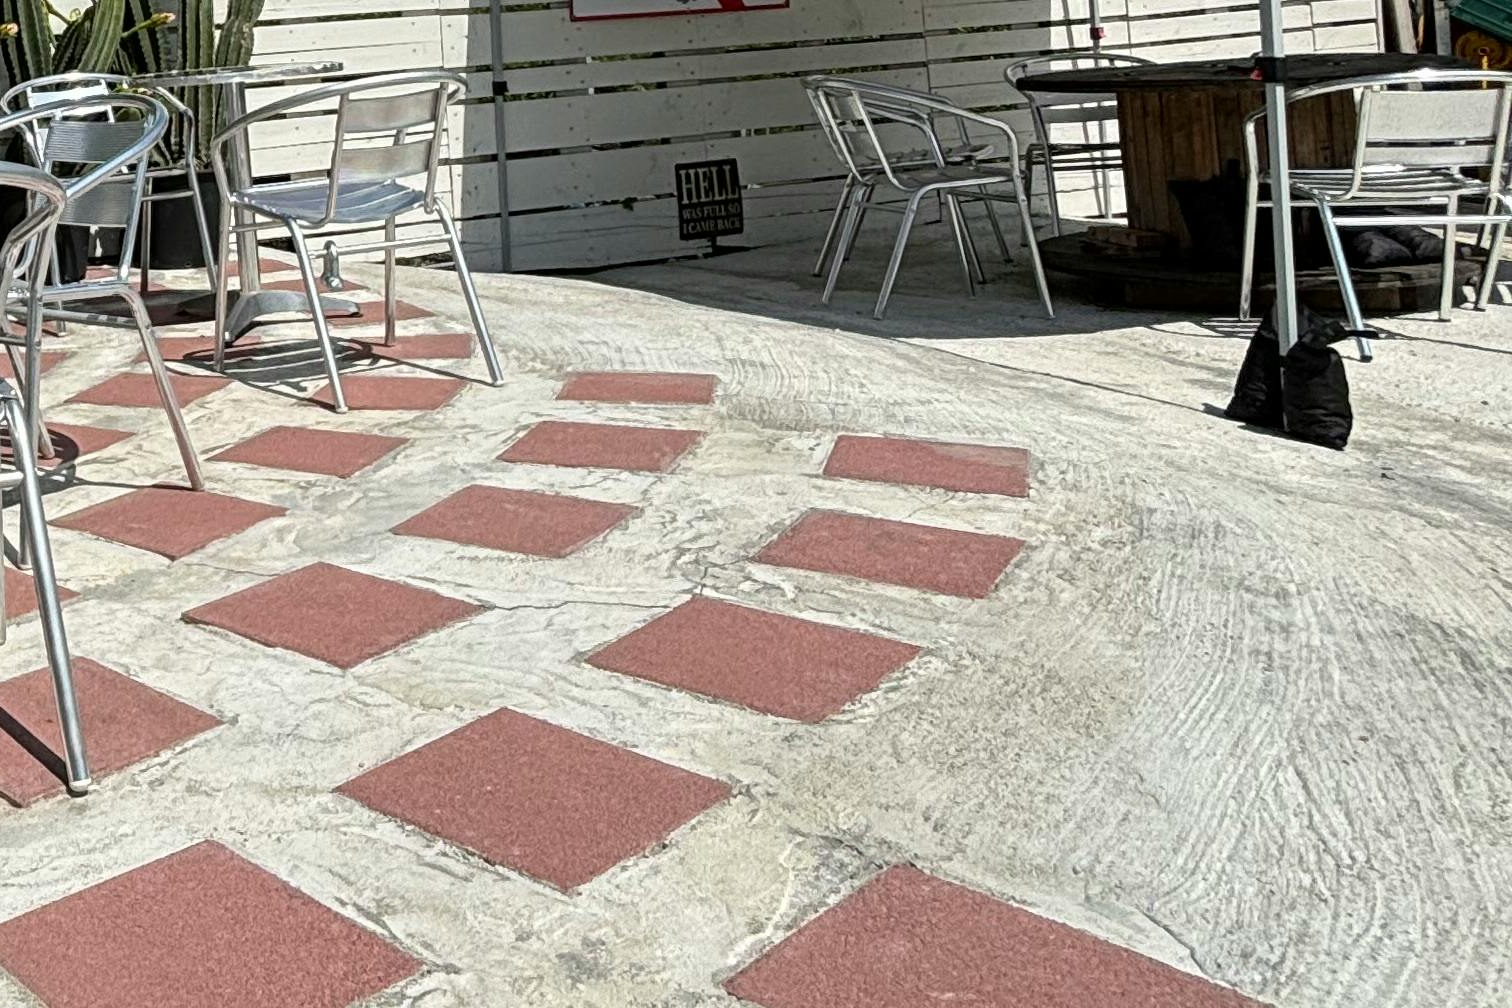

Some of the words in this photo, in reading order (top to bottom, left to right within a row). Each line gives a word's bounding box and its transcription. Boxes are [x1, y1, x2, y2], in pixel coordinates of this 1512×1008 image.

[679, 165, 739, 204] HELL
[682, 207, 702, 220] WAS
[703, 204, 727, 217] FULL
[727, 203, 740, 214] SO
[682, 223, 687, 235] I
[688, 219, 716, 234] CAME
[717, 217, 741, 229] BACK
